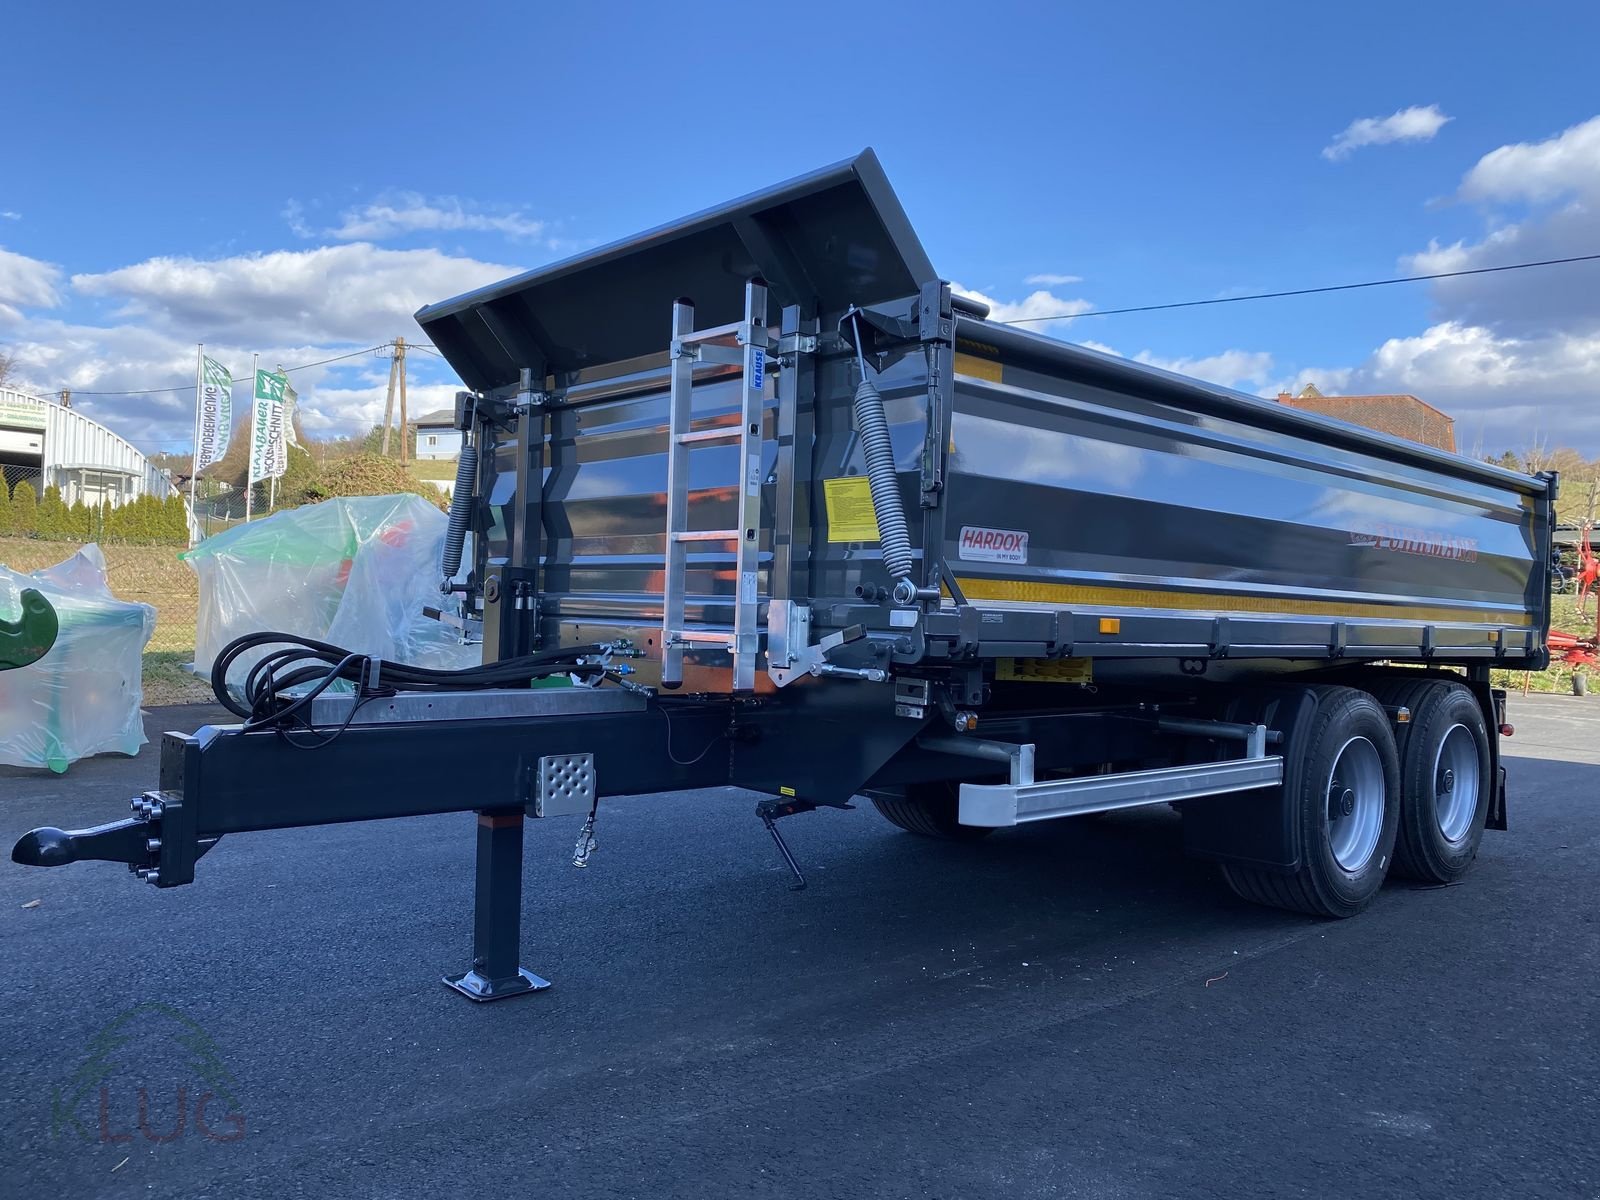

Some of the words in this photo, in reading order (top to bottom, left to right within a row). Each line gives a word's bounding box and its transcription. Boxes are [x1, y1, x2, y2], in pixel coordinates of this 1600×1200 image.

[755, 351, 763, 388] KRAUSE
[252, 401, 269, 478] KLAMBAUER
[962, 529, 1024, 552] HARDOX
